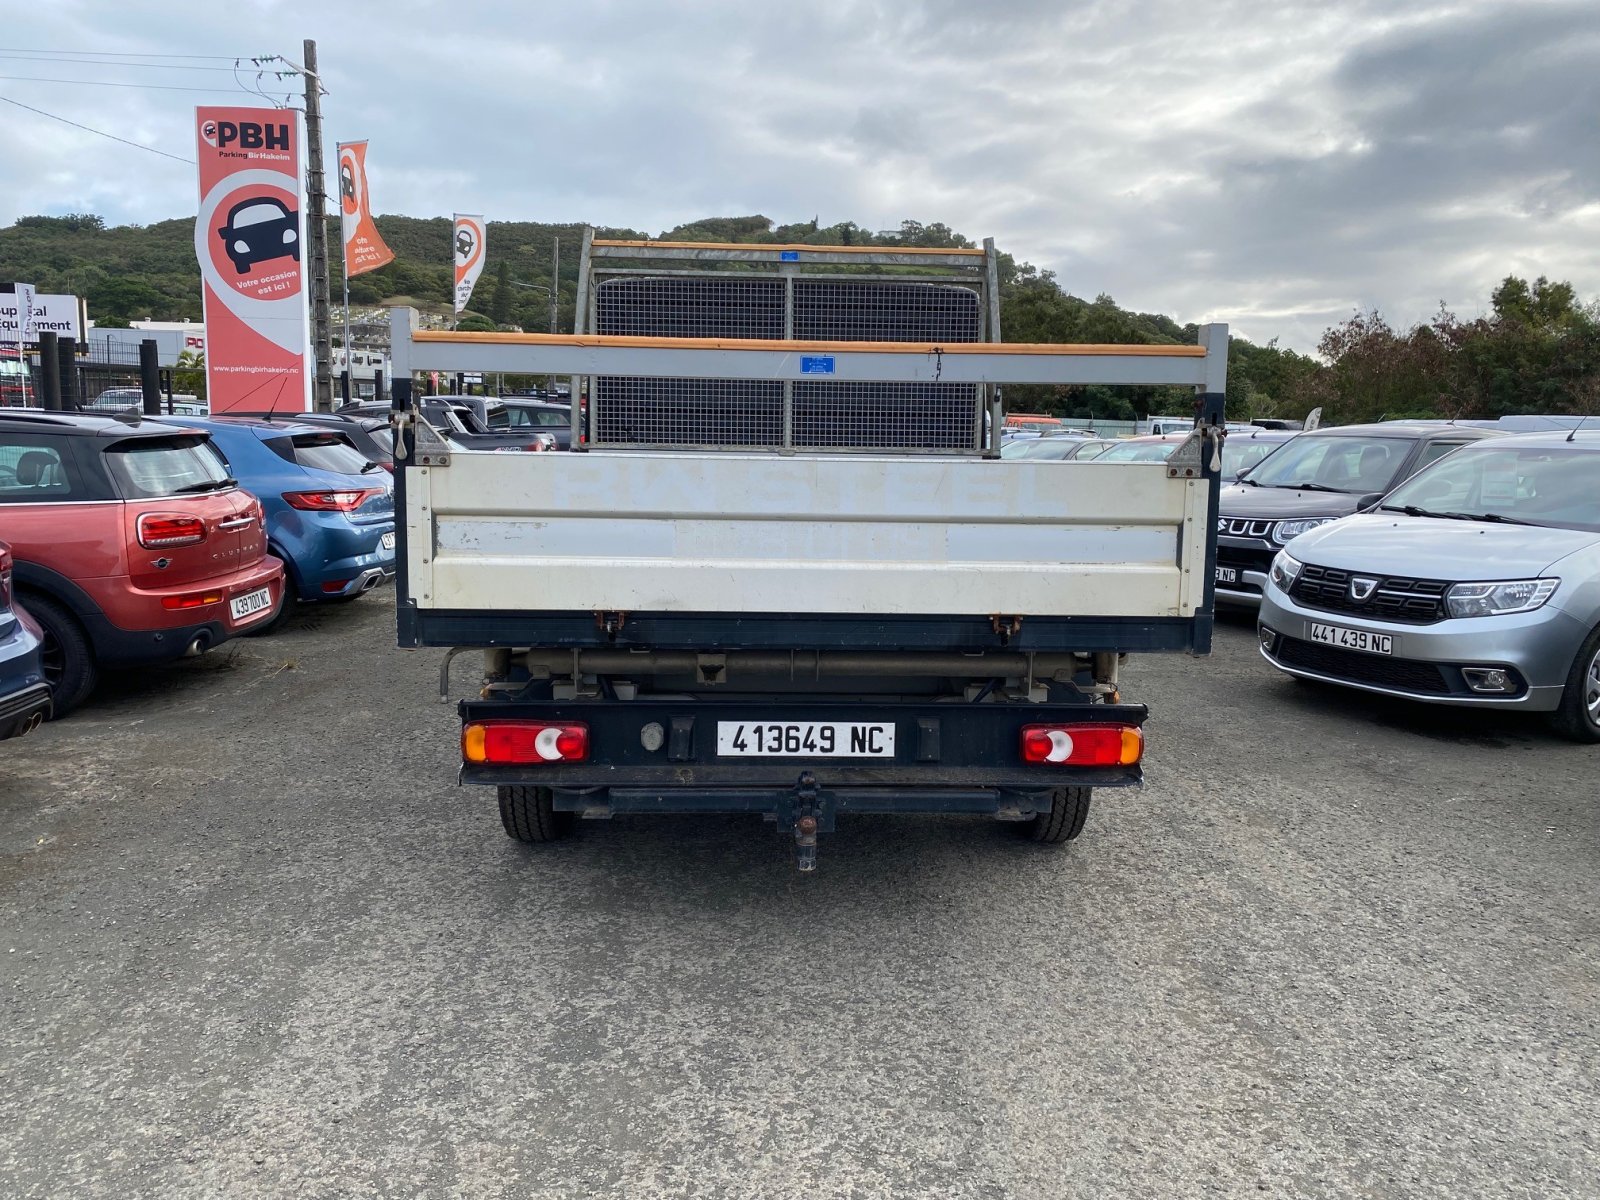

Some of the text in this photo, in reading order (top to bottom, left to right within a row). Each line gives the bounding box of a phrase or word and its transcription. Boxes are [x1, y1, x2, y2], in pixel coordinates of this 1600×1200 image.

[218, 121, 289, 151] PBH
[236, 270, 298, 289] Votre occasion
[257, 285, 273, 295] est
[274, 282, 286, 291] ici
[213, 365, 299, 374] www.parkingbirhakeim.nc
[236, 597, 250, 615] 439
[260, 590, 269, 605] NC
[1313, 624, 1391, 653] 441 439 NC
[732, 725, 884, 753] 413649 NC
